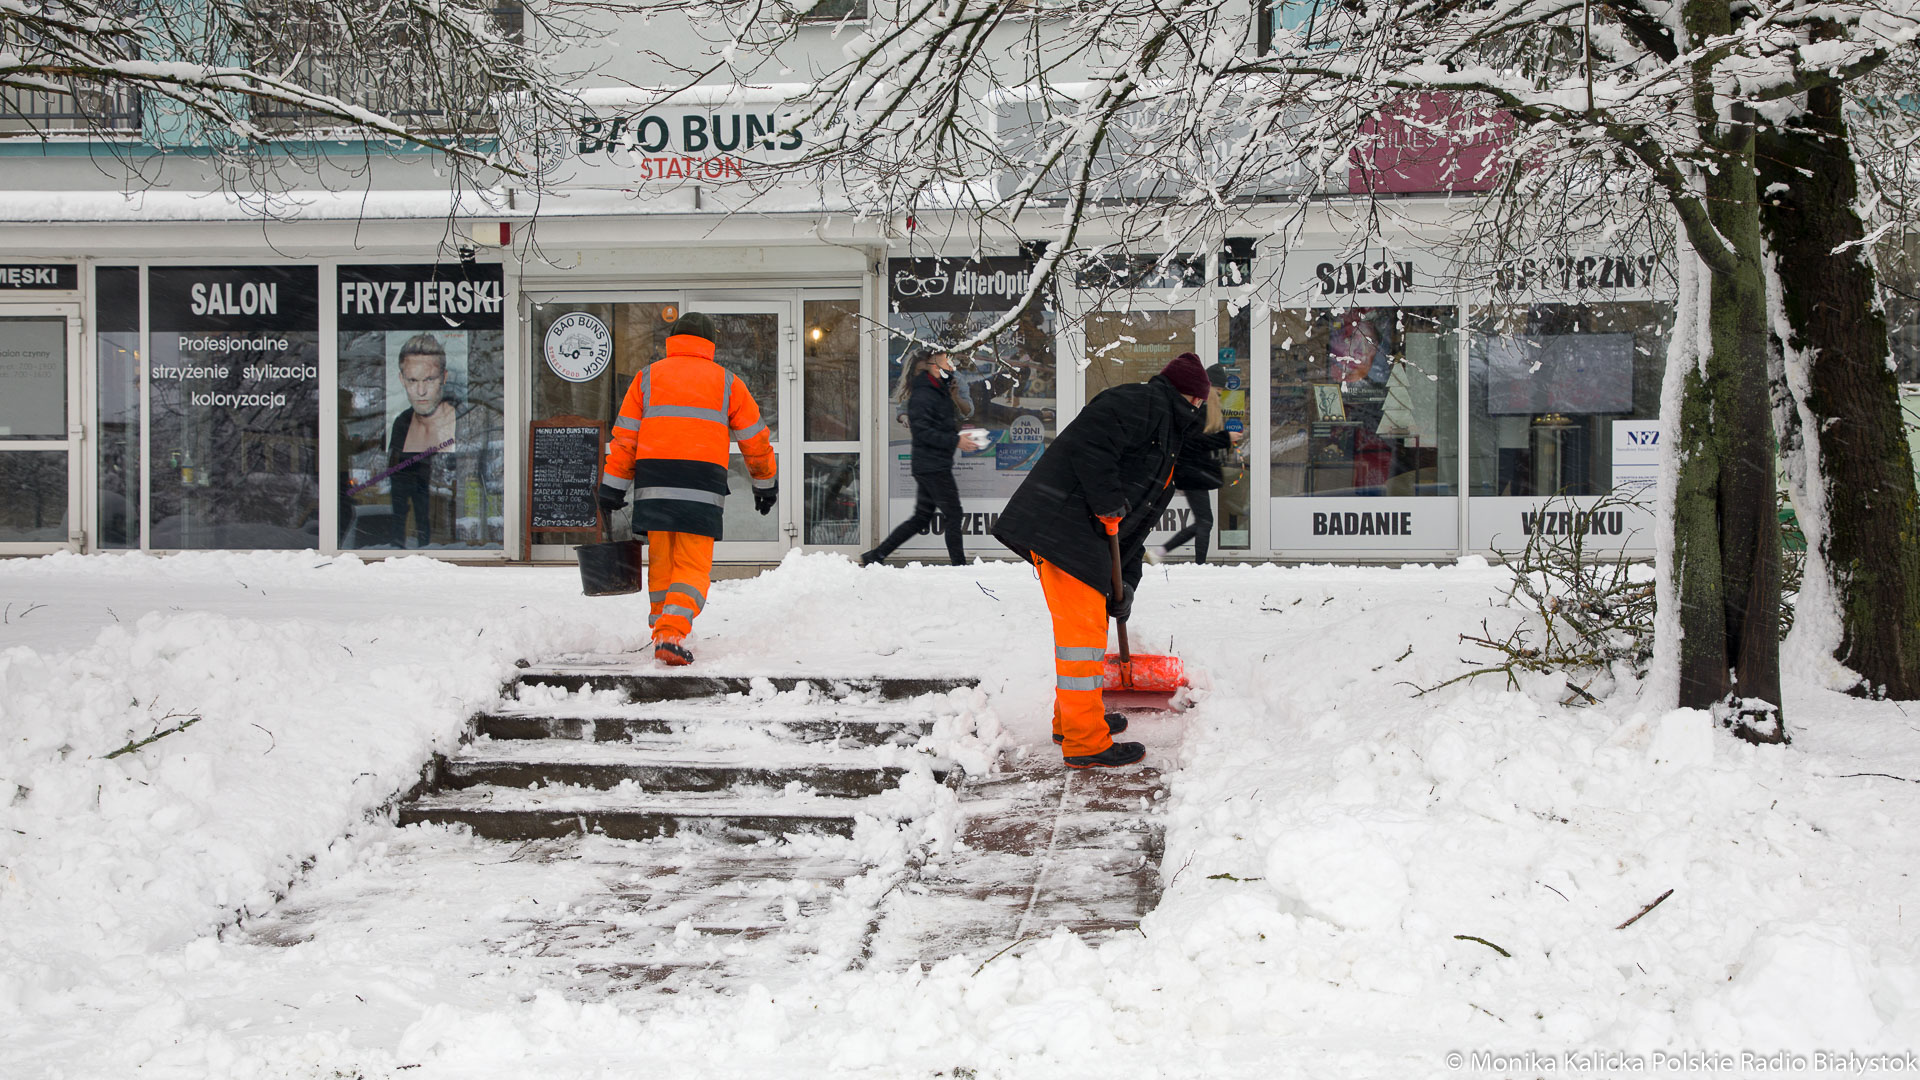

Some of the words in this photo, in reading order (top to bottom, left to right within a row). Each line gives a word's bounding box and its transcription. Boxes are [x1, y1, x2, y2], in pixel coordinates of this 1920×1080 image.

[578, 115, 669, 153] BAO
[682, 113, 803, 153] BUNS
[640, 157, 743, 179] STATION
[1221, 263, 1248, 276] 194
[1316, 261, 1413, 295] SALON
[953, 270, 1050, 300] AlterOpti
[191, 282, 278, 315] SALON
[341, 280, 500, 314] FRYZJERSKI
[553, 318, 575, 336] BAO
[578, 317, 605, 340] BUNS
[179, 336, 289, 354] Profesjonalne
[1134, 344, 1171, 353] AlterOptica
[21, 350, 51, 359] czynny
[583, 342, 608, 375] TRUCK
[152, 364, 230, 382] strzyżenie
[243, 363, 317, 381] stylizacja
[561, 368, 580, 378] FOOD
[191, 391, 286, 409] koloryzacja
[1222, 409, 1244, 417] Nikon
[1012, 427, 1023, 435] 30
[1024, 427, 1040, 435] DNI
[1627, 431, 1660, 446] NFZ
[1313, 511, 1412, 536] BADANIE
[1521, 511, 1623, 535] WZROKU
